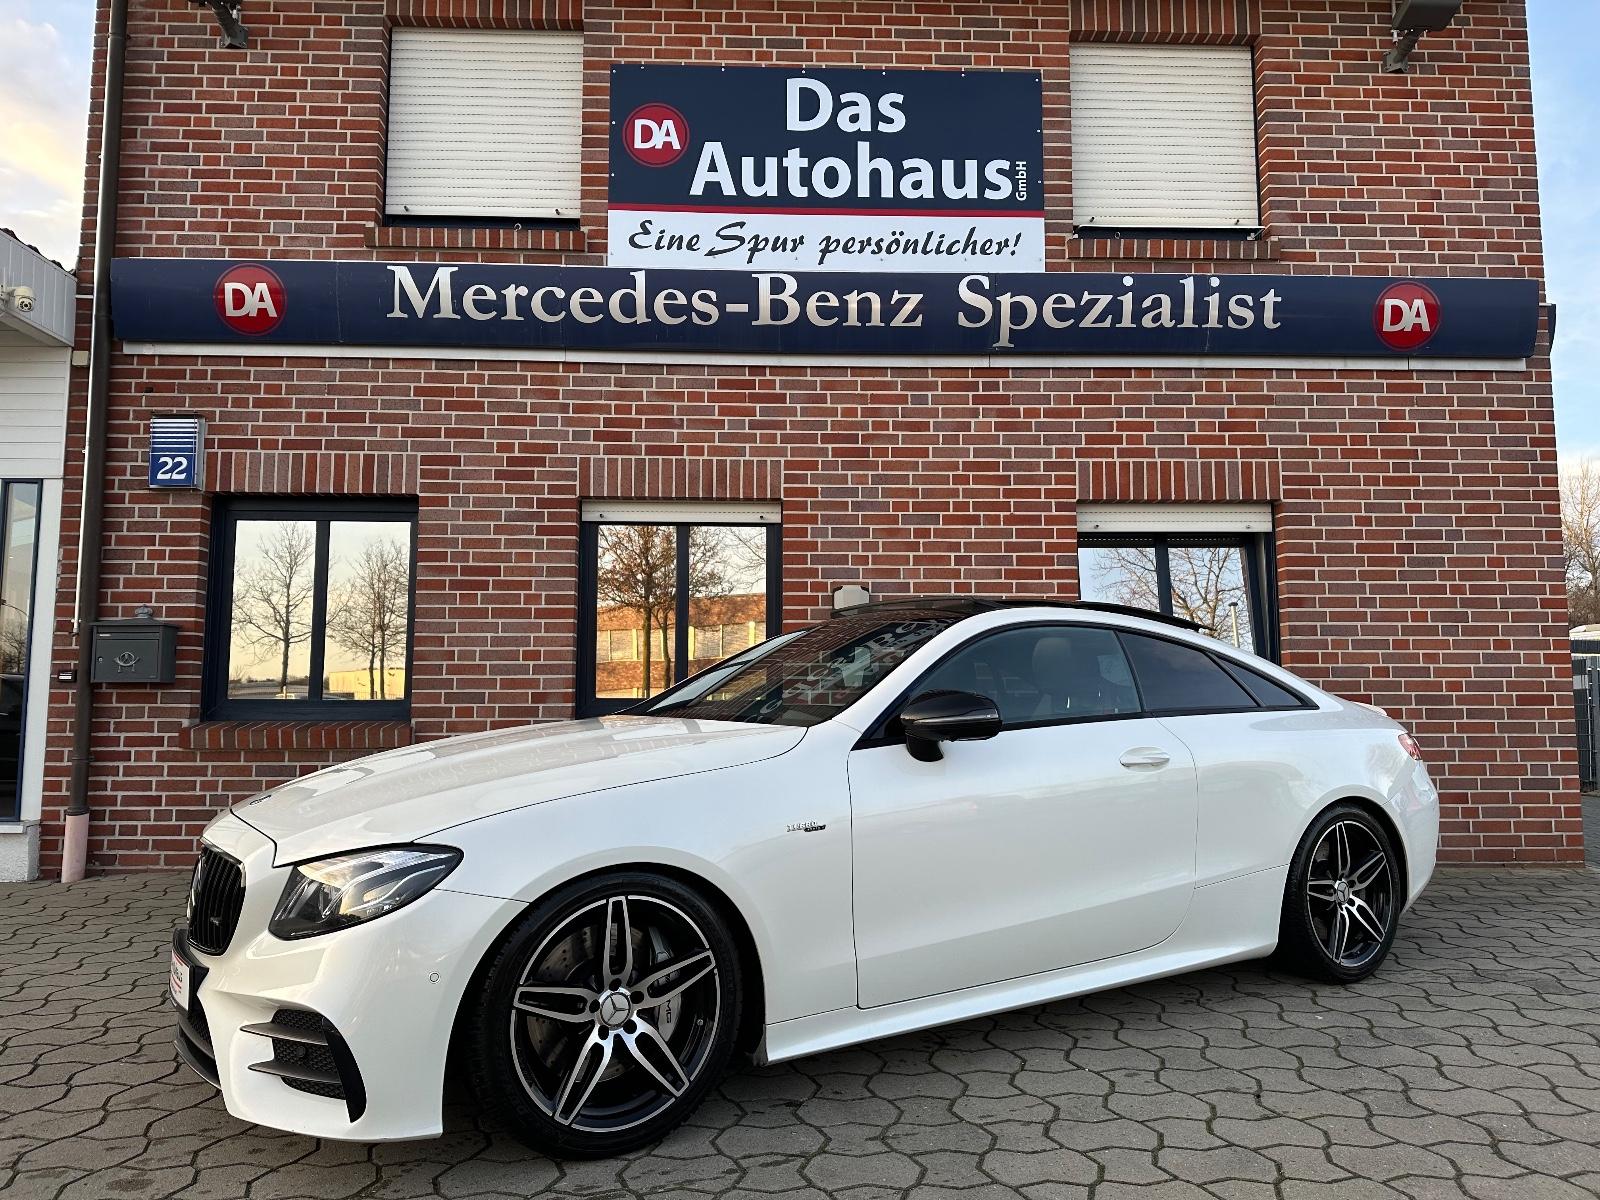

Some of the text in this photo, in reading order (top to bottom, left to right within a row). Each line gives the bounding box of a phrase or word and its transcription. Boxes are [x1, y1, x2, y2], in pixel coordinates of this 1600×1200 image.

[786, 77, 907, 133] Das
[633, 118, 681, 150] DA
[689, 140, 1013, 200] Autohaus
[1015, 160, 1027, 201] GmbH
[628, 219, 1022, 266] Eine Spur persönlicher!
[223, 281, 278, 318] DA
[386, 265, 1282, 348] Mercedes-Benz Spezialist
[1382, 298, 1431, 332] DA
[156, 456, 188, 480] 22
